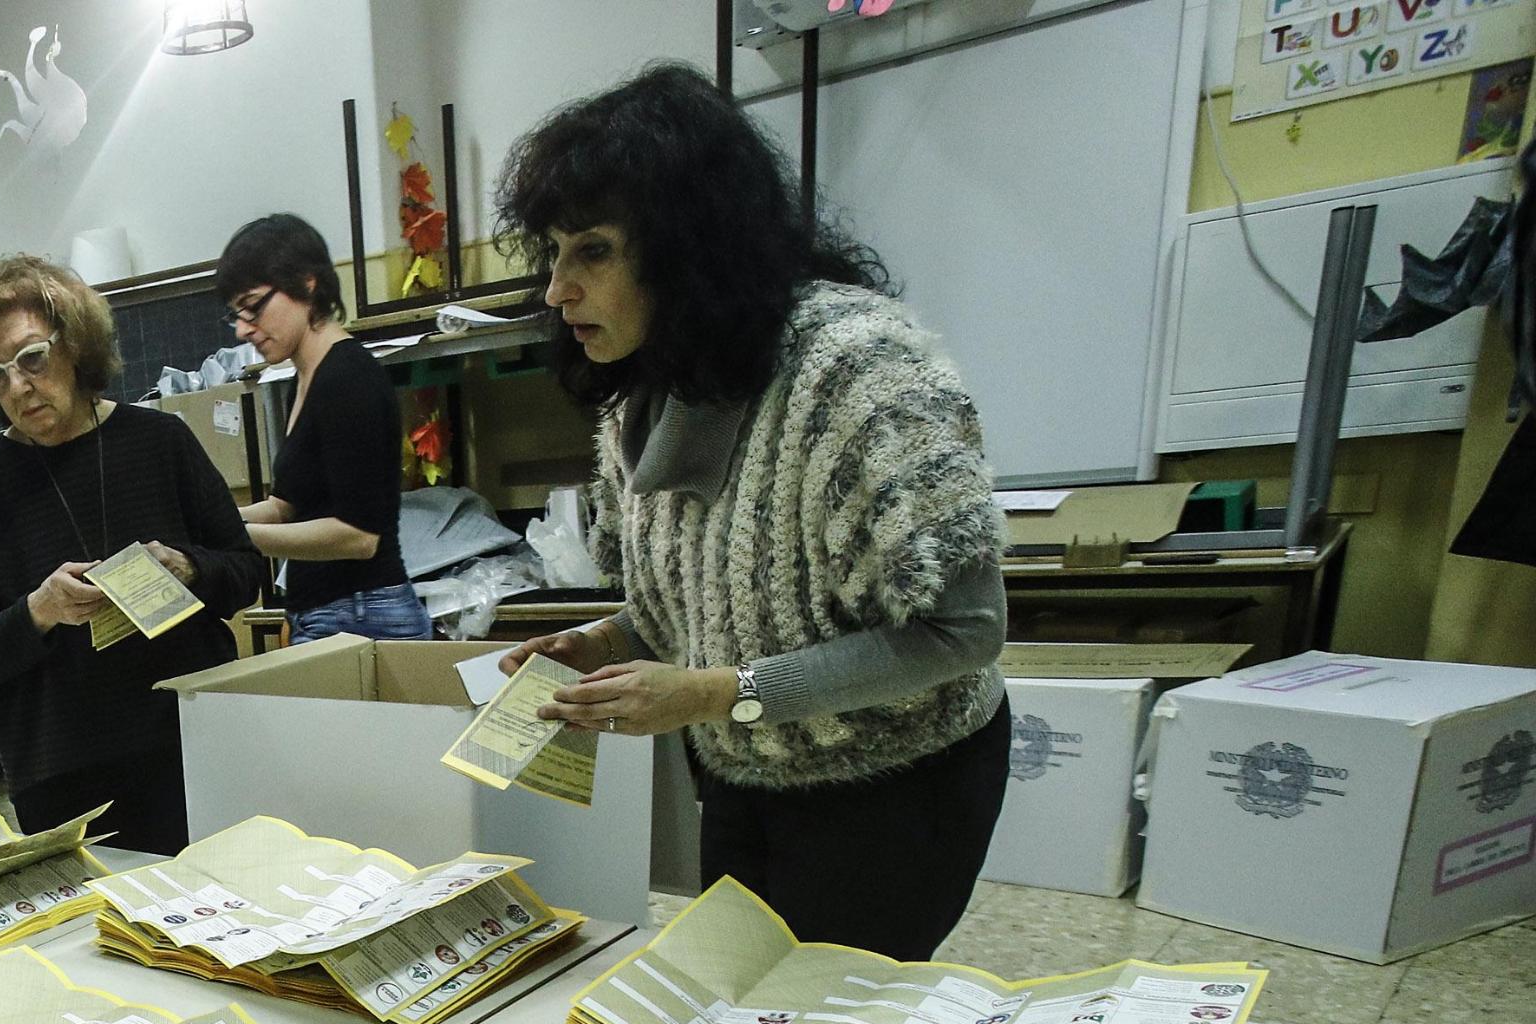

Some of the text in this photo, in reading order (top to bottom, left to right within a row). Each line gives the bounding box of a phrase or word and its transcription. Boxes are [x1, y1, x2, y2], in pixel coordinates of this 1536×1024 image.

[1271, 24, 1291, 52] T
[1332, 7, 1360, 37] U
[1294, 62, 1318, 89] X
[1420, 29, 1448, 61] Z
